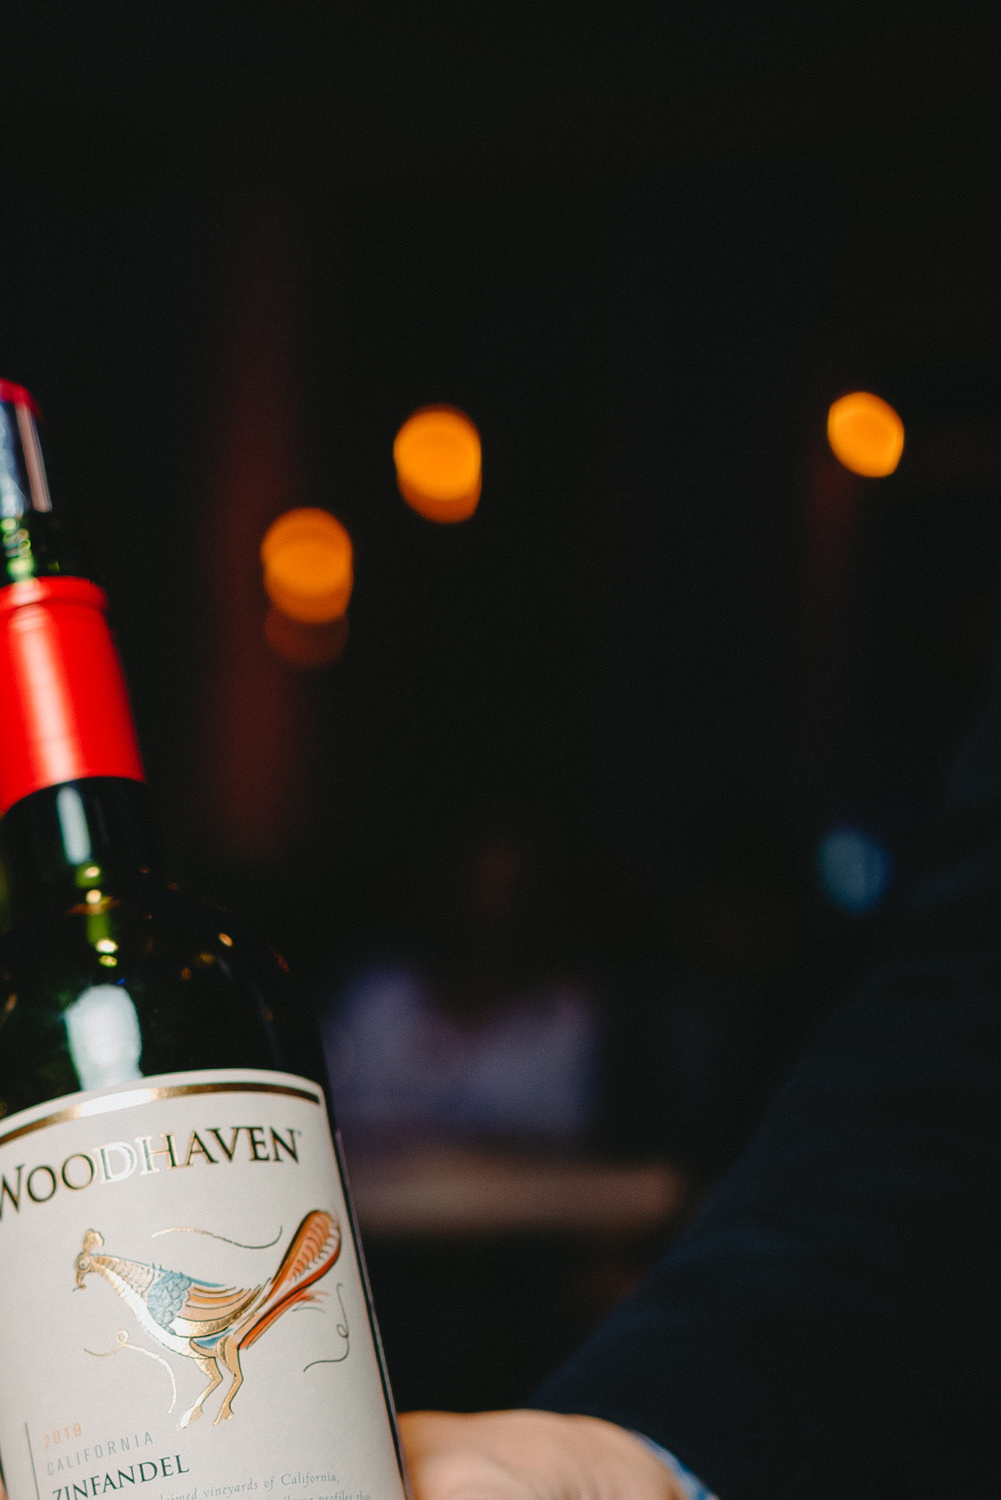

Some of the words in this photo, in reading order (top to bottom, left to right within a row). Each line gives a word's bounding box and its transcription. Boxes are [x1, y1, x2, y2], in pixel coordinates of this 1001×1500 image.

[44, 1422, 83, 1449] 2019
[47, 1431, 154, 1476] CALIFORNIA
[203, 1477, 259, 1498] vineyards
[264, 1476, 275, 1492] of
[281, 1472, 340, 1488] California,
